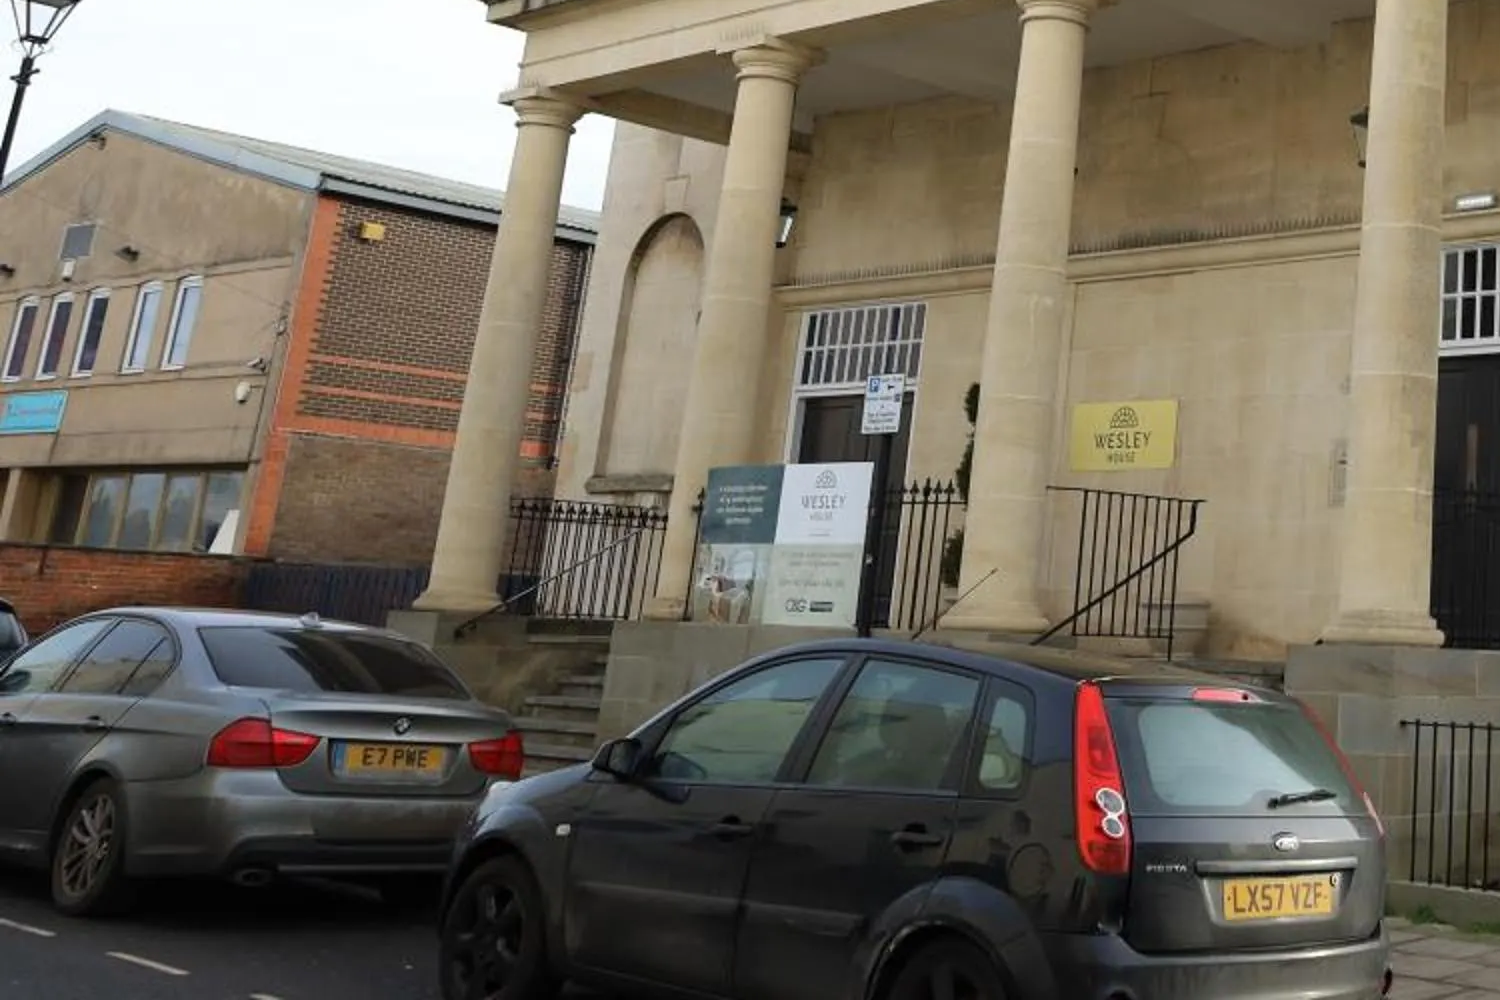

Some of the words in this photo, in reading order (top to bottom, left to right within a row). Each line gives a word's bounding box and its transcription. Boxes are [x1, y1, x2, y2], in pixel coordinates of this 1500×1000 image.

[1094, 431, 1152, 449] WESLEY
[801, 494, 846, 509] WESLEY
[362, 747, 388, 766] E7
[1232, 884, 1285, 914] LX57
[1290, 882, 1324, 910] VZF
